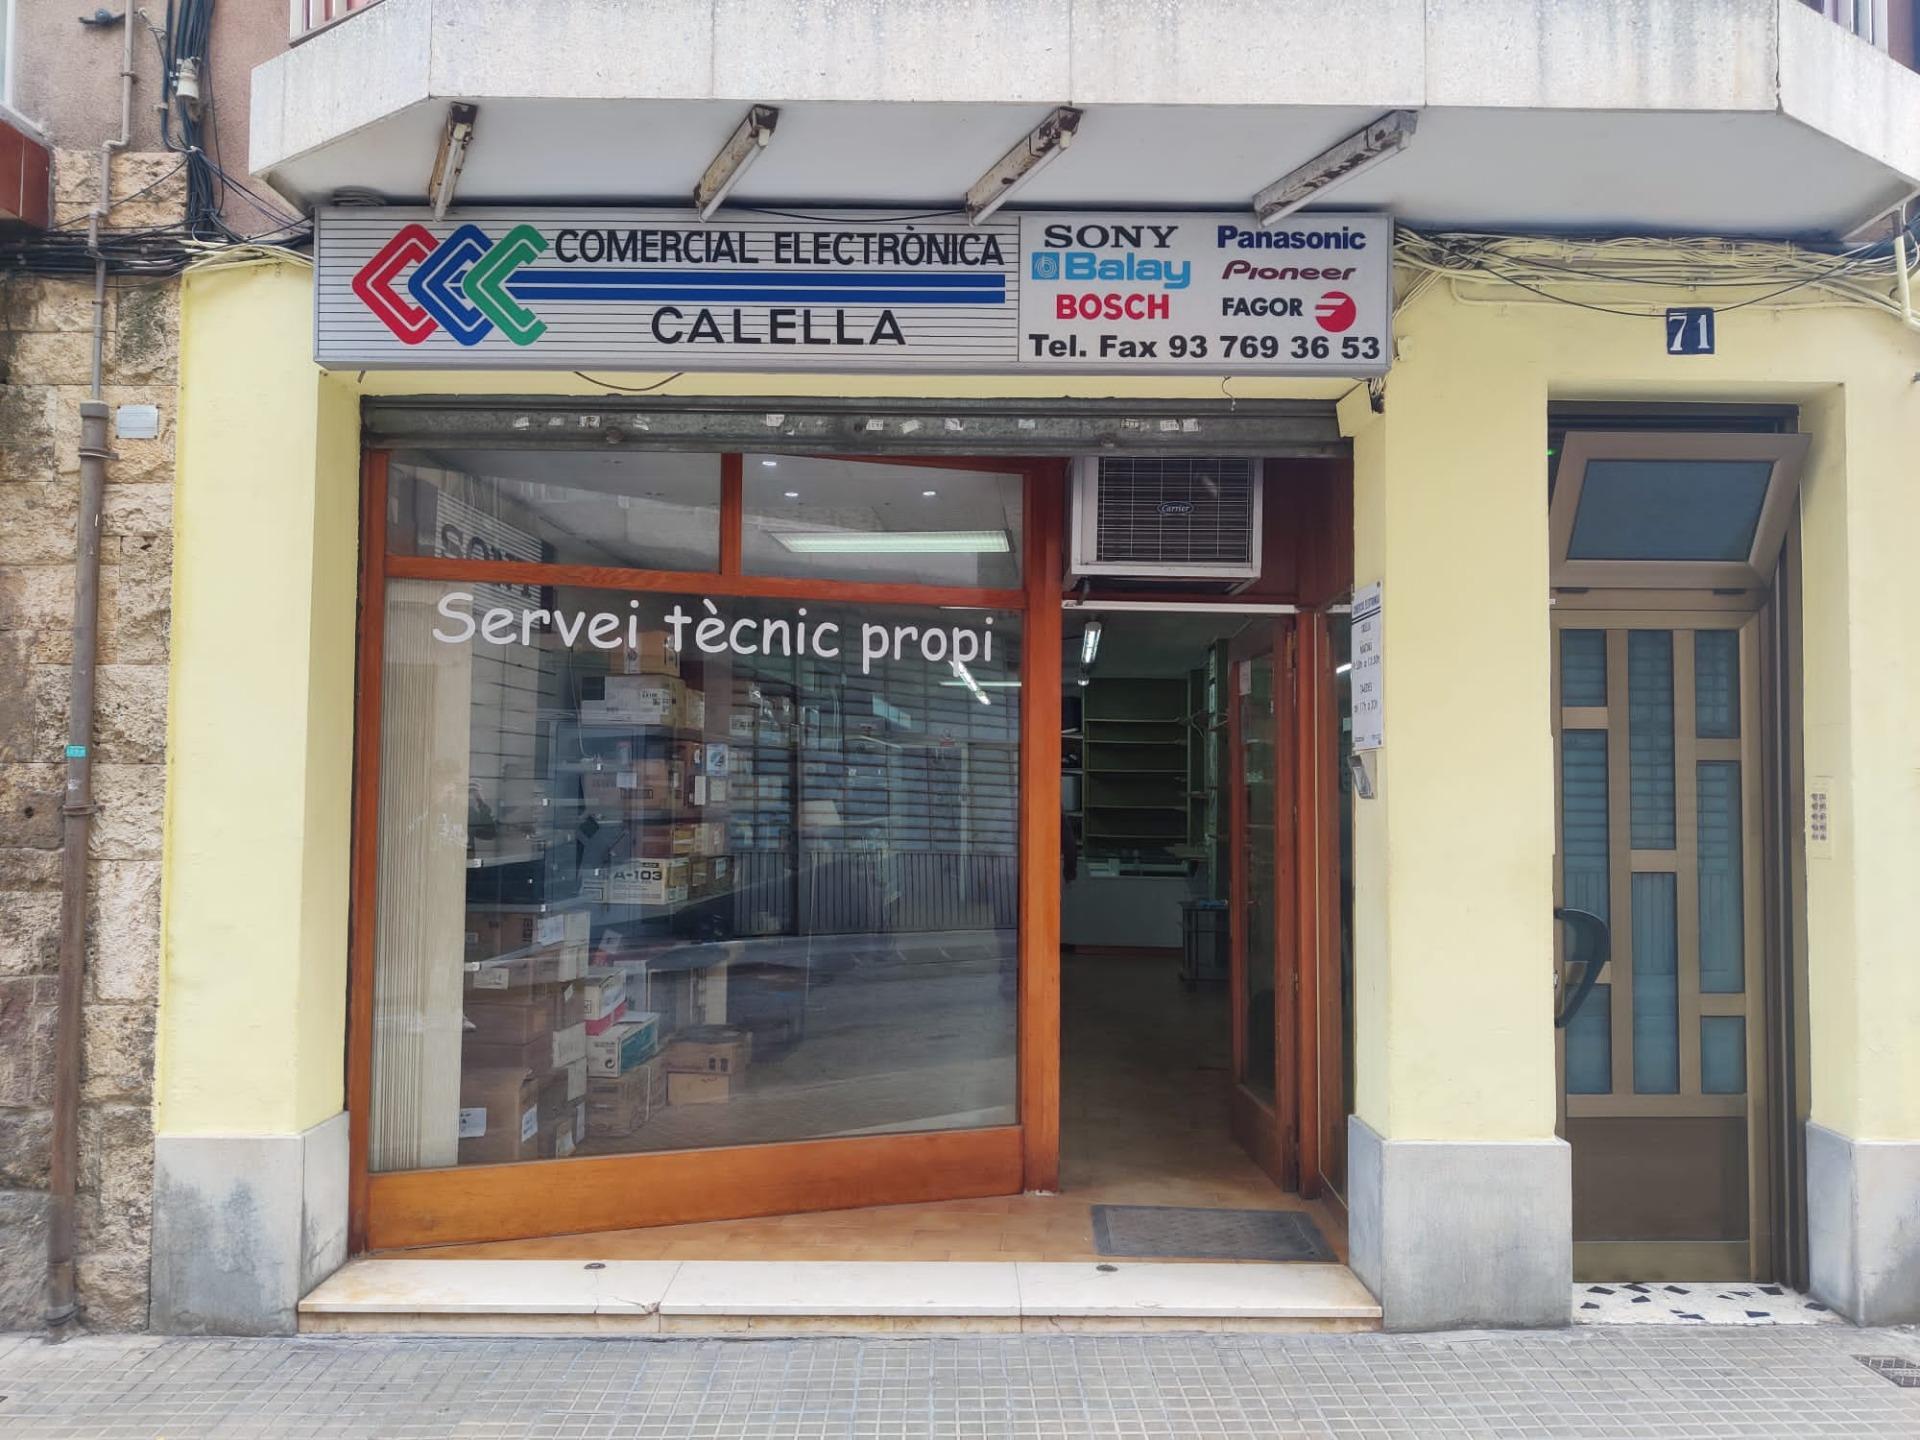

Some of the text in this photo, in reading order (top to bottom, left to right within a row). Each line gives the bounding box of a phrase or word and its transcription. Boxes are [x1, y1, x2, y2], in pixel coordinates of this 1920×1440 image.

[555, 225, 1004, 265] COMERCIAL ELECTRÒNICA
[1044, 224, 1178, 248] SONY
[1217, 225, 1366, 250] Panasonic
[1065, 252, 1190, 289] Balay
[1221, 259, 1357, 281] Pioneer
[1056, 293, 1169, 320] BOSCH
[1222, 297, 1303, 317] FAGOR
[651, 305, 906, 345] CALELLA
[1669, 312, 1710, 351] 71
[1028, 333, 1380, 360] Tel. Fax 93 769 36 53
[432, 592, 994, 678] Servei tècnic propi
[614, 870, 662, 881] A-103
